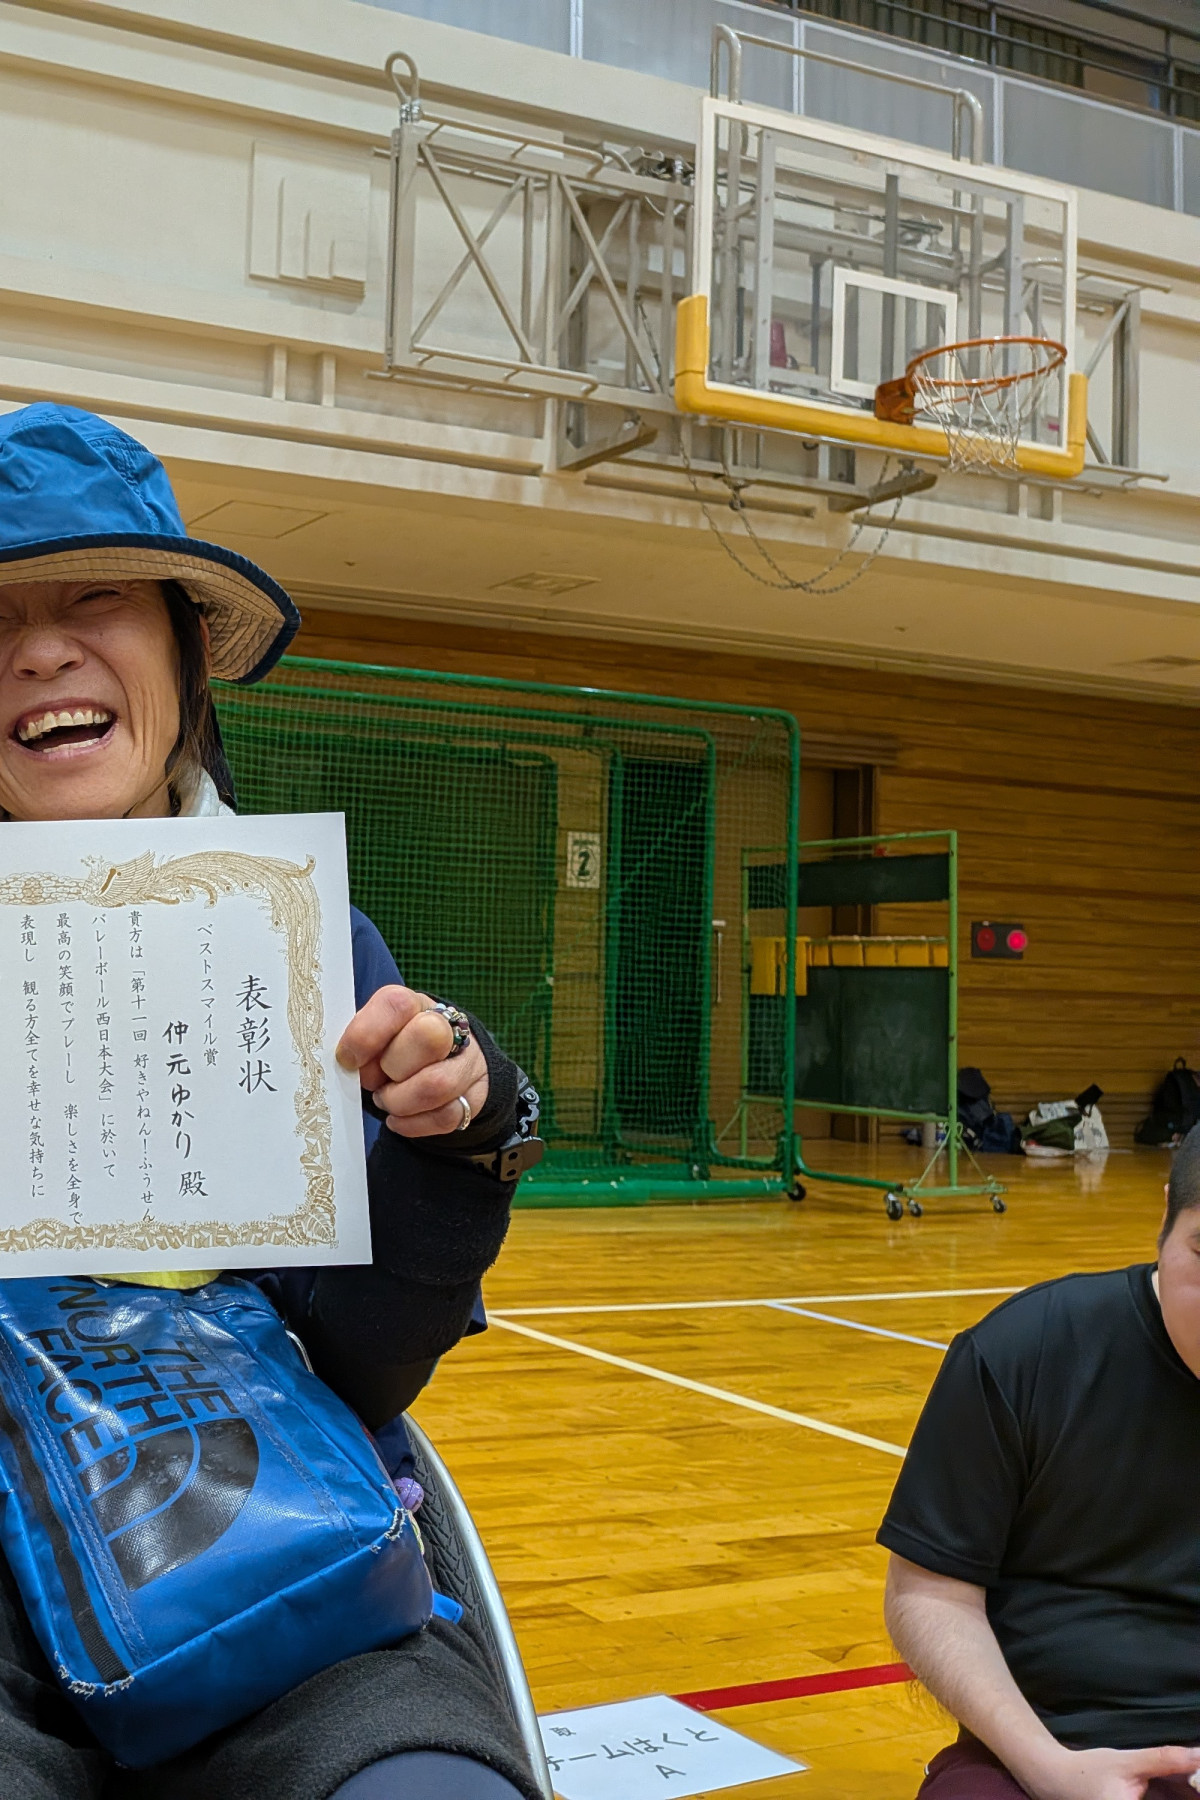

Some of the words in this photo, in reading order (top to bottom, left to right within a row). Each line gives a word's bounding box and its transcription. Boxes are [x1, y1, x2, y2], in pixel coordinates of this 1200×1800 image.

[577, 851, 590, 877] 2
[20, 913, 37, 962] 表現し
[56, 912, 76, 1084] 最高の笑顔でプレーし
[197, 923, 220, 1067] ベストスマイル賞
[22, 980, 45, 1198] 観る方全てを幸せな気持ちに
[235, 974, 279, 1095] 表彰状
[63, 1103, 83, 1225] 楽しさを全身で
[161, 1020, 195, 1160] 仲元ゆかり
[178, 1170, 209, 1198] 殿
[24, 1327, 130, 1468] FACE
[48, 1285, 183, 1436] NORTH
[143, 1340, 241, 1419] THE
[656, 1763, 687, 1779] A
